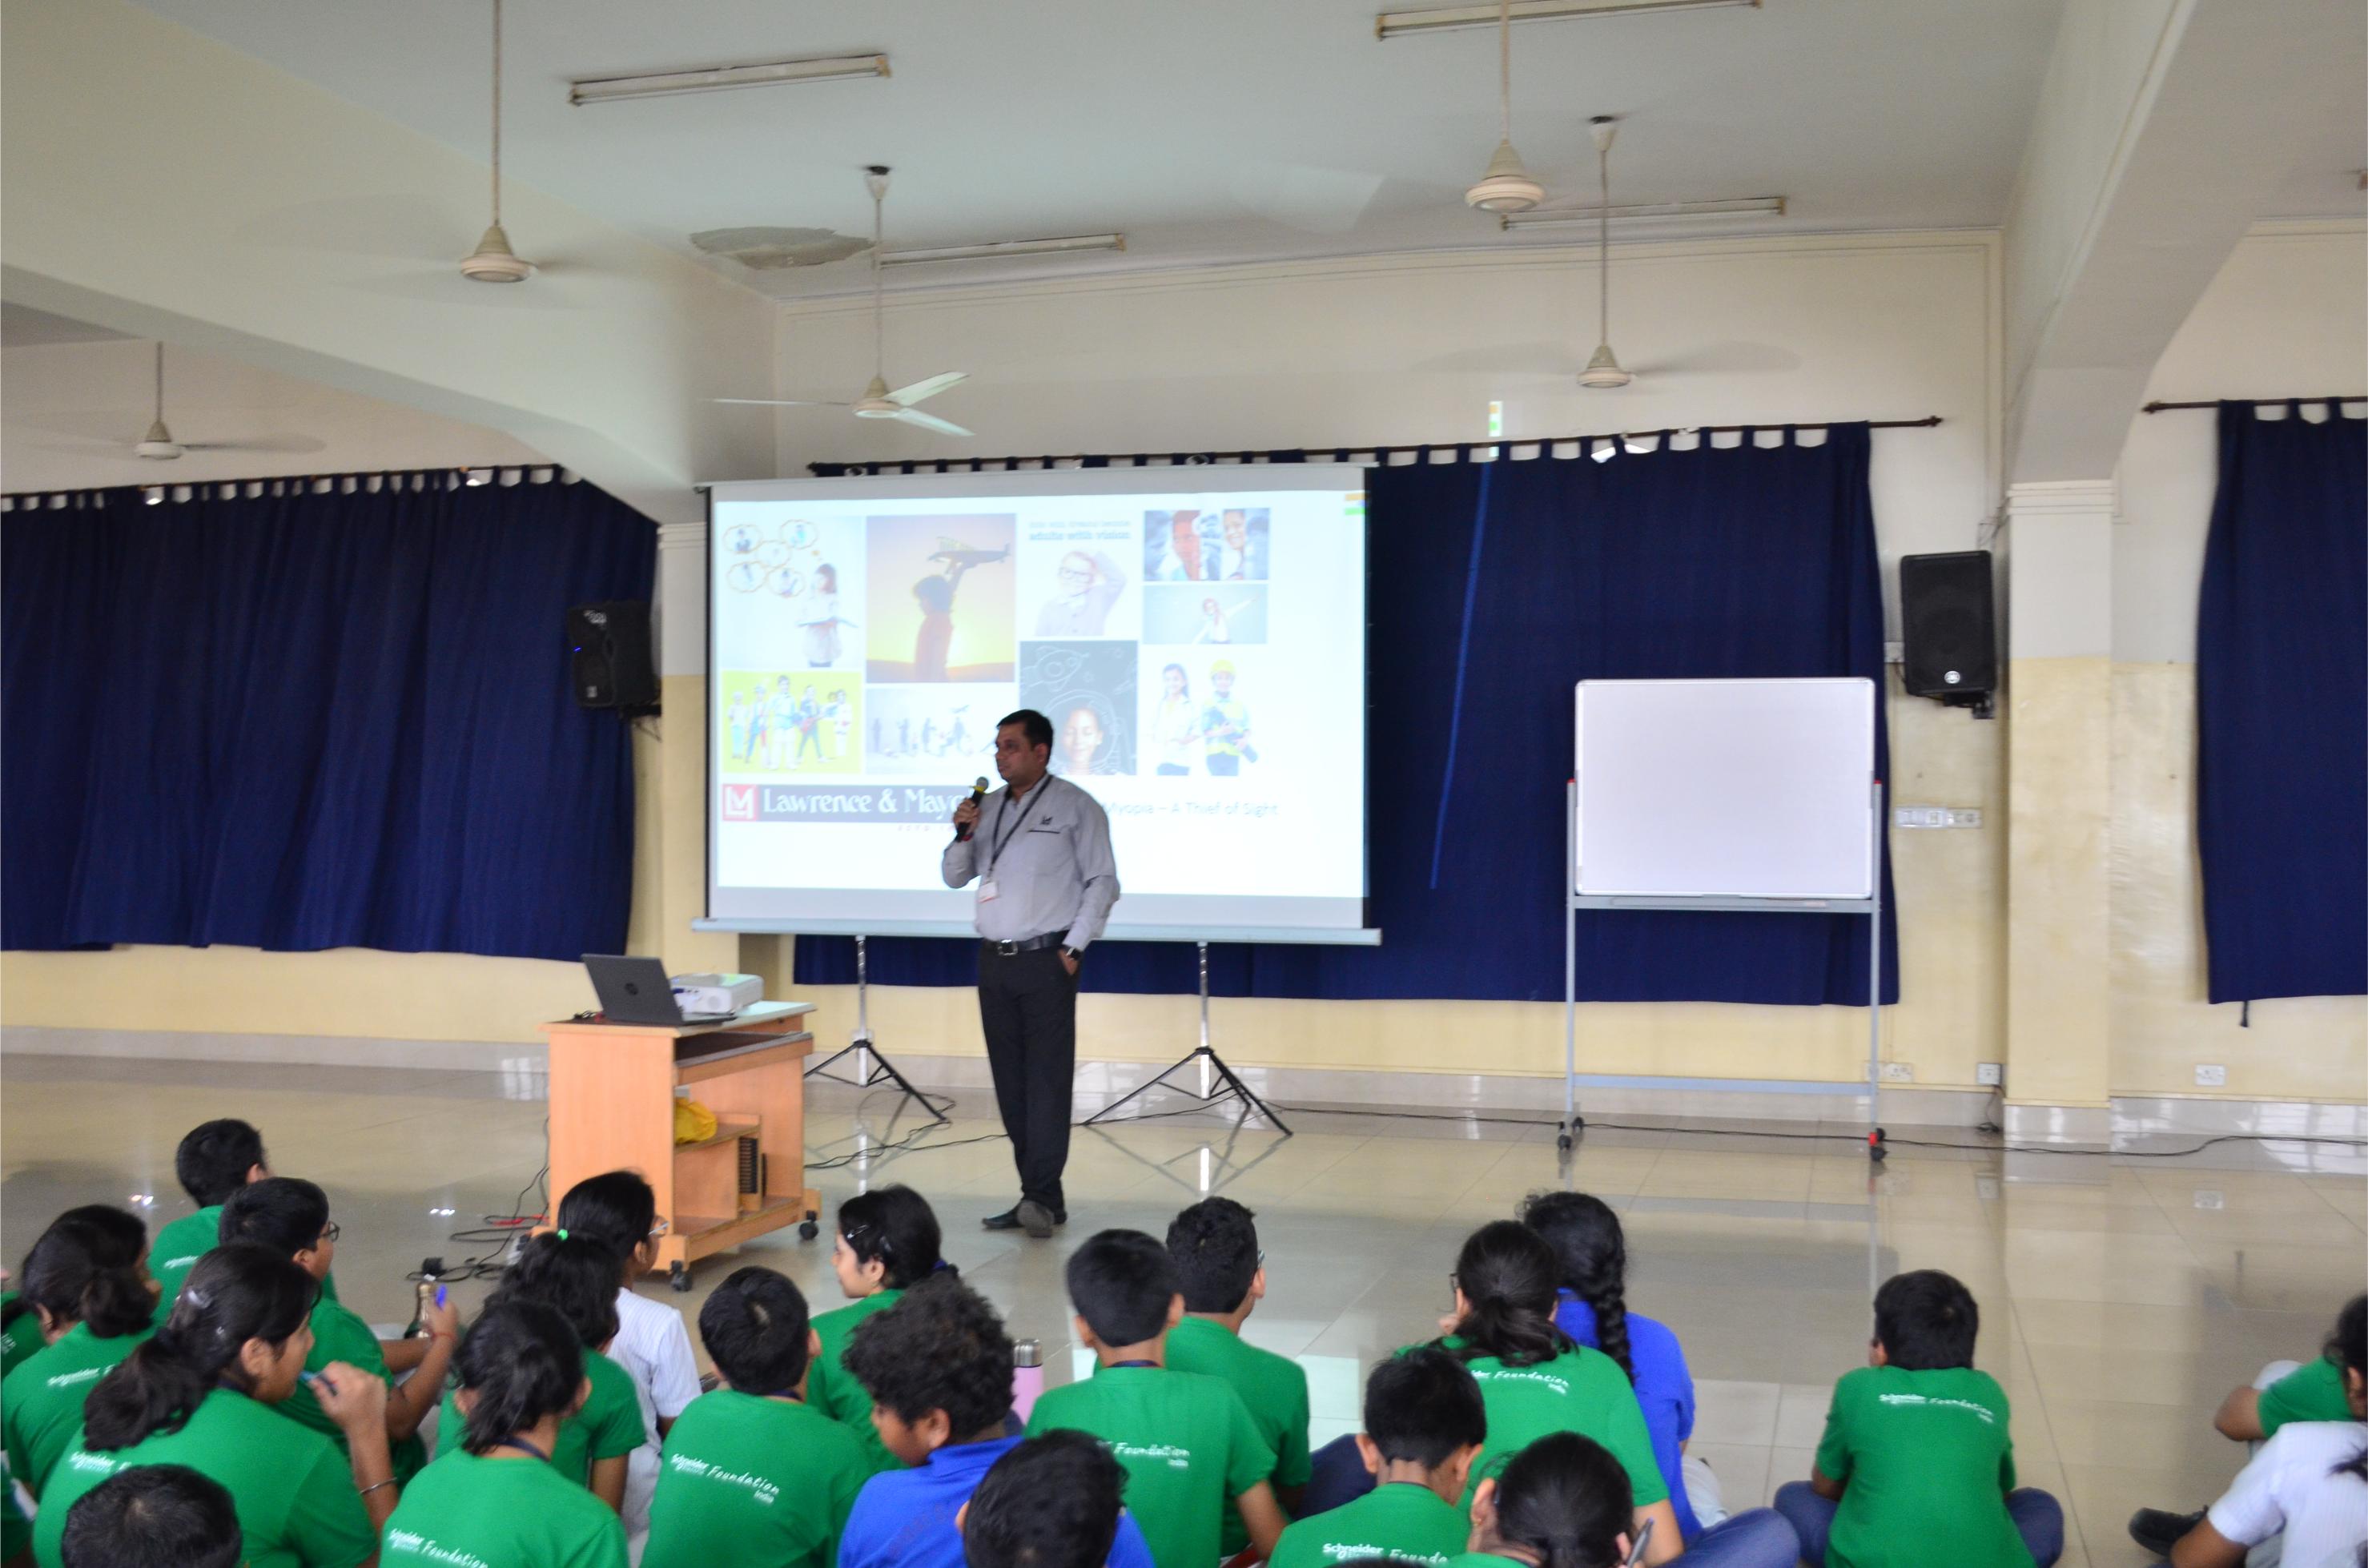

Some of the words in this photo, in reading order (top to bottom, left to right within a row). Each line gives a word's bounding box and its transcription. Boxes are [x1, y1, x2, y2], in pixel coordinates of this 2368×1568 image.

[762, 788, 871, 814] Lawrence
[878, 787, 898, 814] &
[1493, 1370, 1570, 1387] Foundation
[1113, 1442, 1191, 1457] Foundation
[706, 1465, 781, 1495] Foundation
[1322, 1542, 1385, 1560] Schneider
